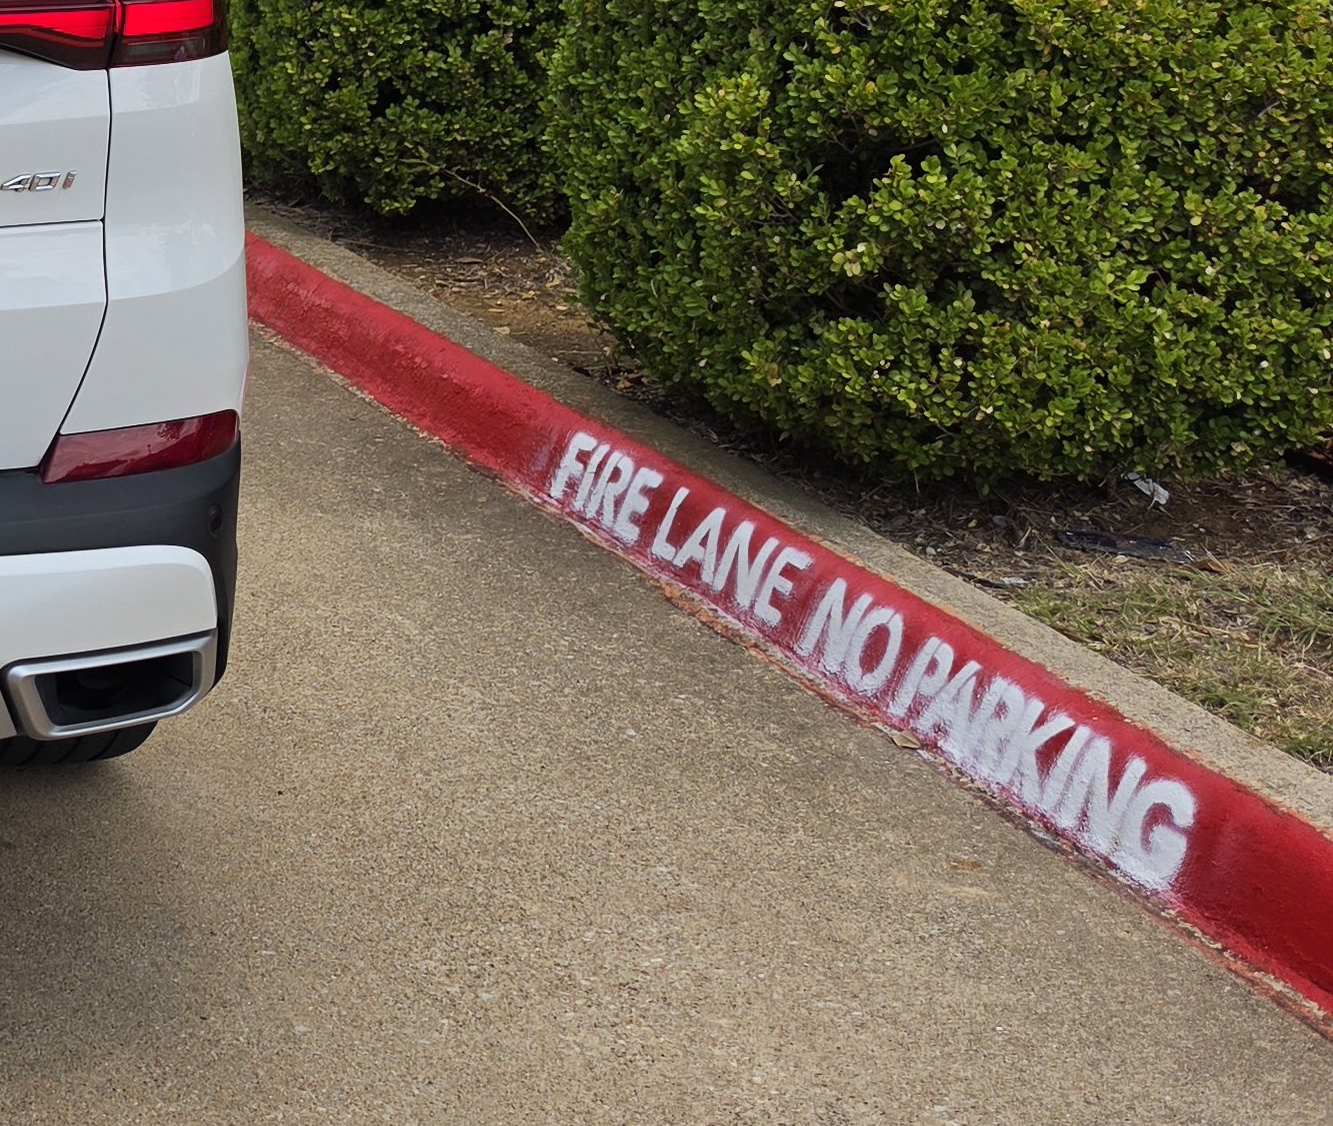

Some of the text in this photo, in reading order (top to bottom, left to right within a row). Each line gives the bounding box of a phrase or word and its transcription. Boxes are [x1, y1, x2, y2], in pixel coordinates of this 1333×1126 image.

[550, 431, 1196, 893] FIRE LANE NO PARKING
